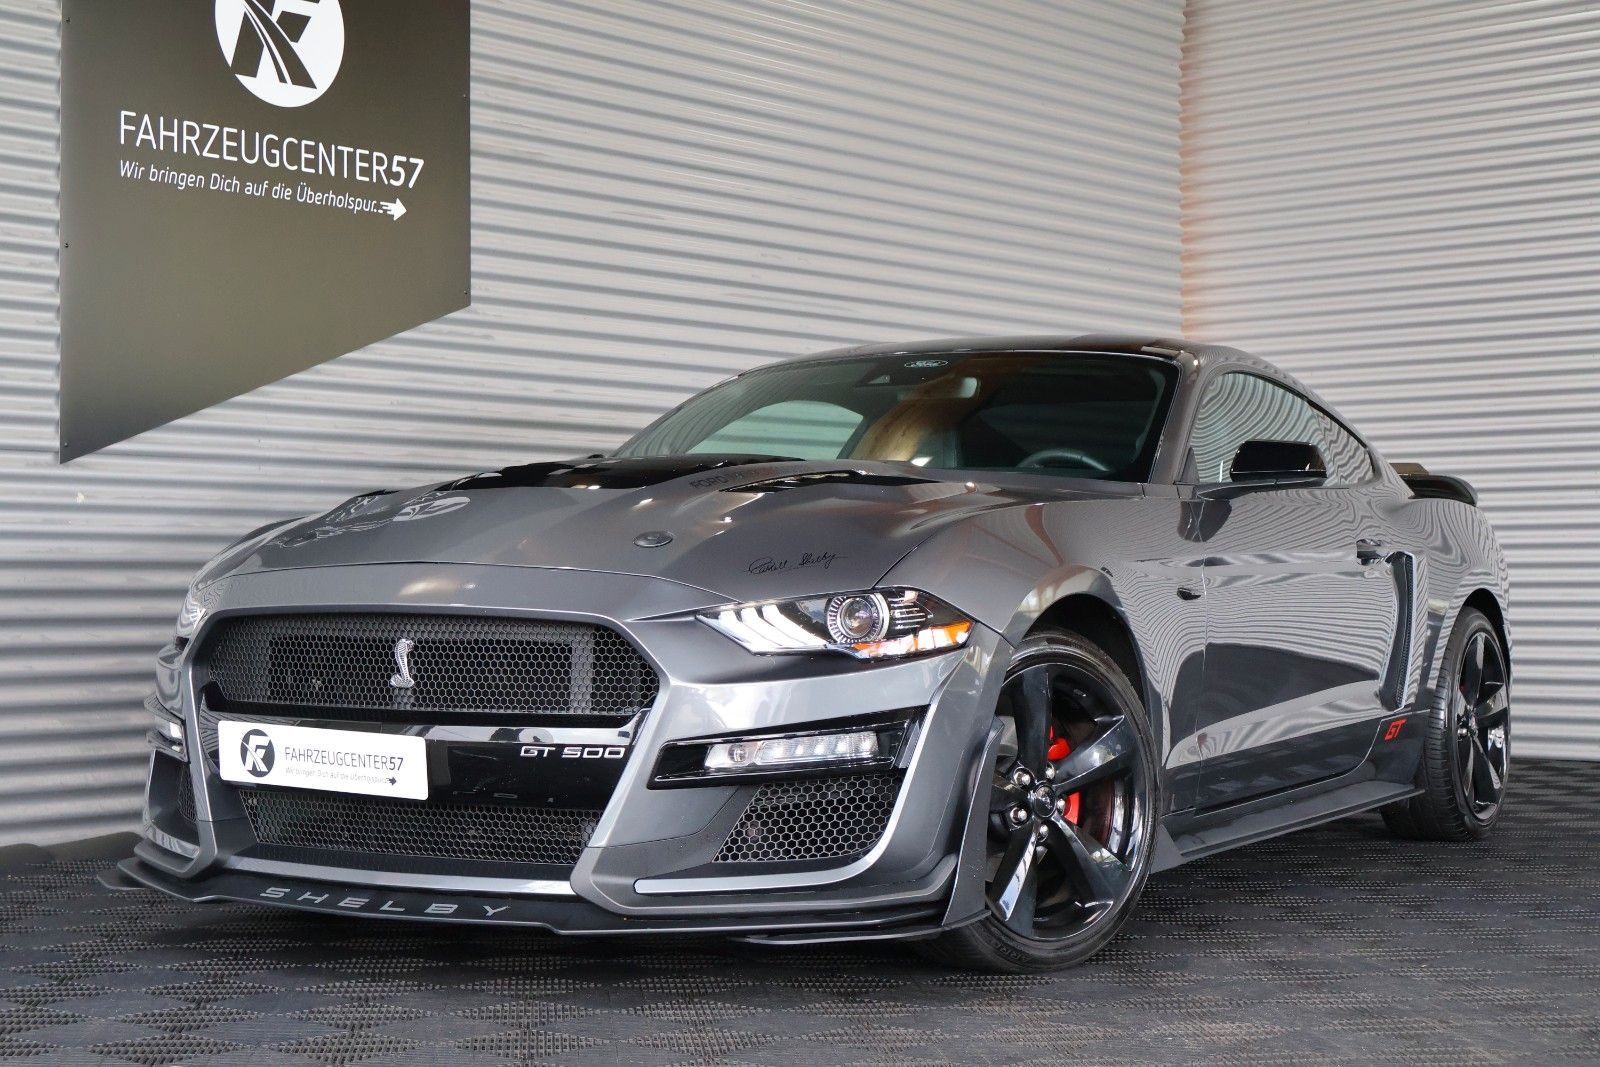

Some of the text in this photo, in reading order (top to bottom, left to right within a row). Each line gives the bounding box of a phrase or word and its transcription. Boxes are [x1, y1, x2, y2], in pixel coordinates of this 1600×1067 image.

[120, 110, 425, 189] FAHRZEUGCENTER57
[120, 159, 145, 179] Wir
[149, 164, 205, 190] bringen
[210, 173, 240, 193] Dich
[244, 181, 269, 197] auf
[272, 183, 292, 200] die
[1384, 719, 1407, 740] GT
[285, 747, 404, 771] FAHRZEUGCENTER57
[520, 745, 626, 759] GT 500
[259, 887, 511, 917] SHELBY
